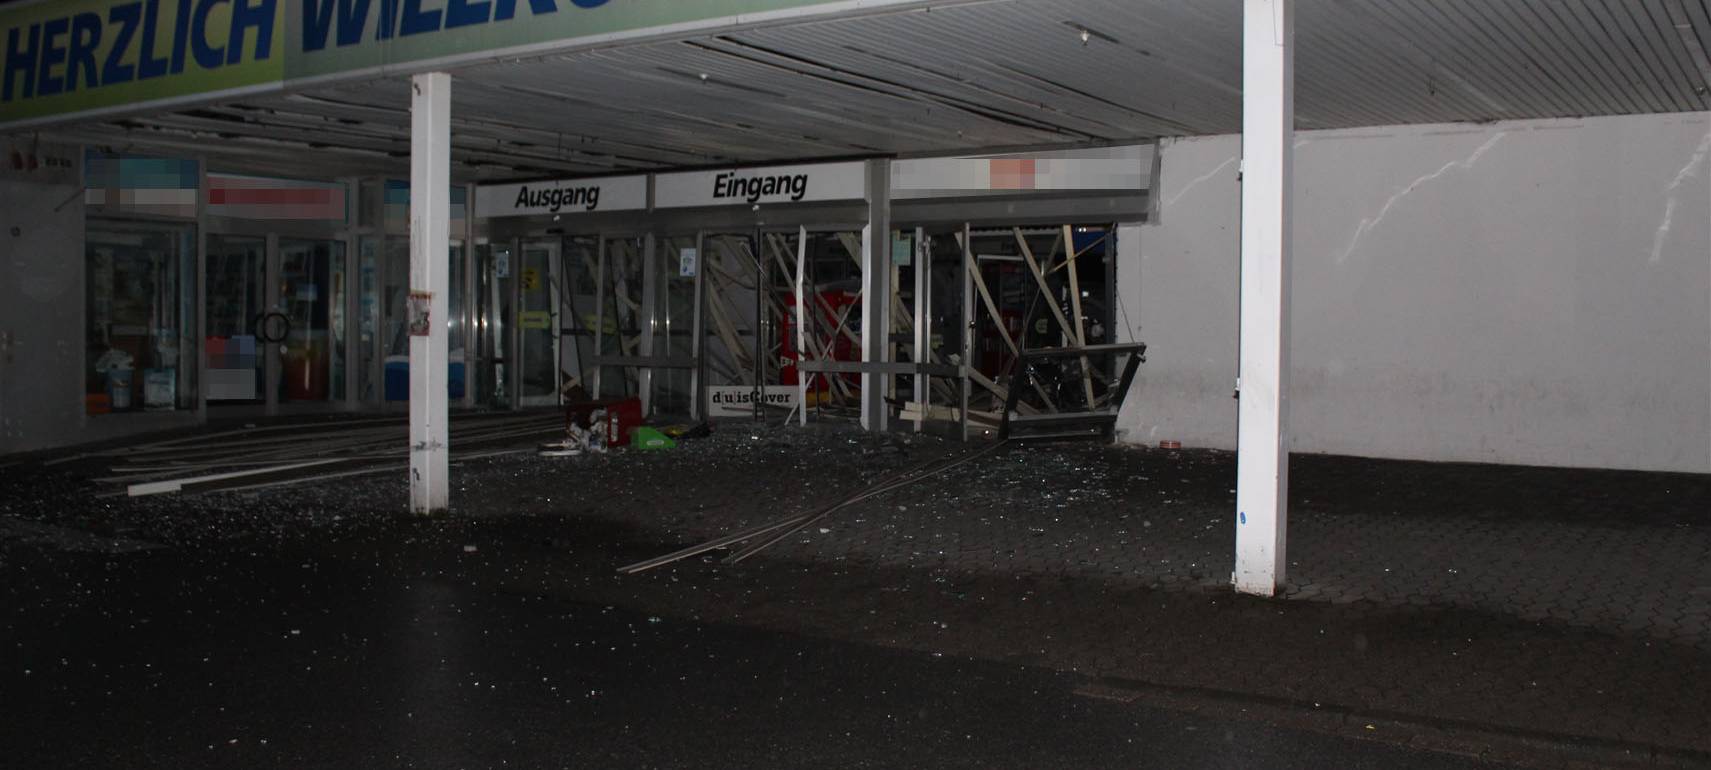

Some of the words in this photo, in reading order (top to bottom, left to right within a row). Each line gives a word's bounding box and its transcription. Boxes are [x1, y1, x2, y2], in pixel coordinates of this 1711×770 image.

[3, 0, 277, 101] HERZLICH
[515, 185, 600, 210] Ausgang
[713, 172, 807, 203] Eingang
